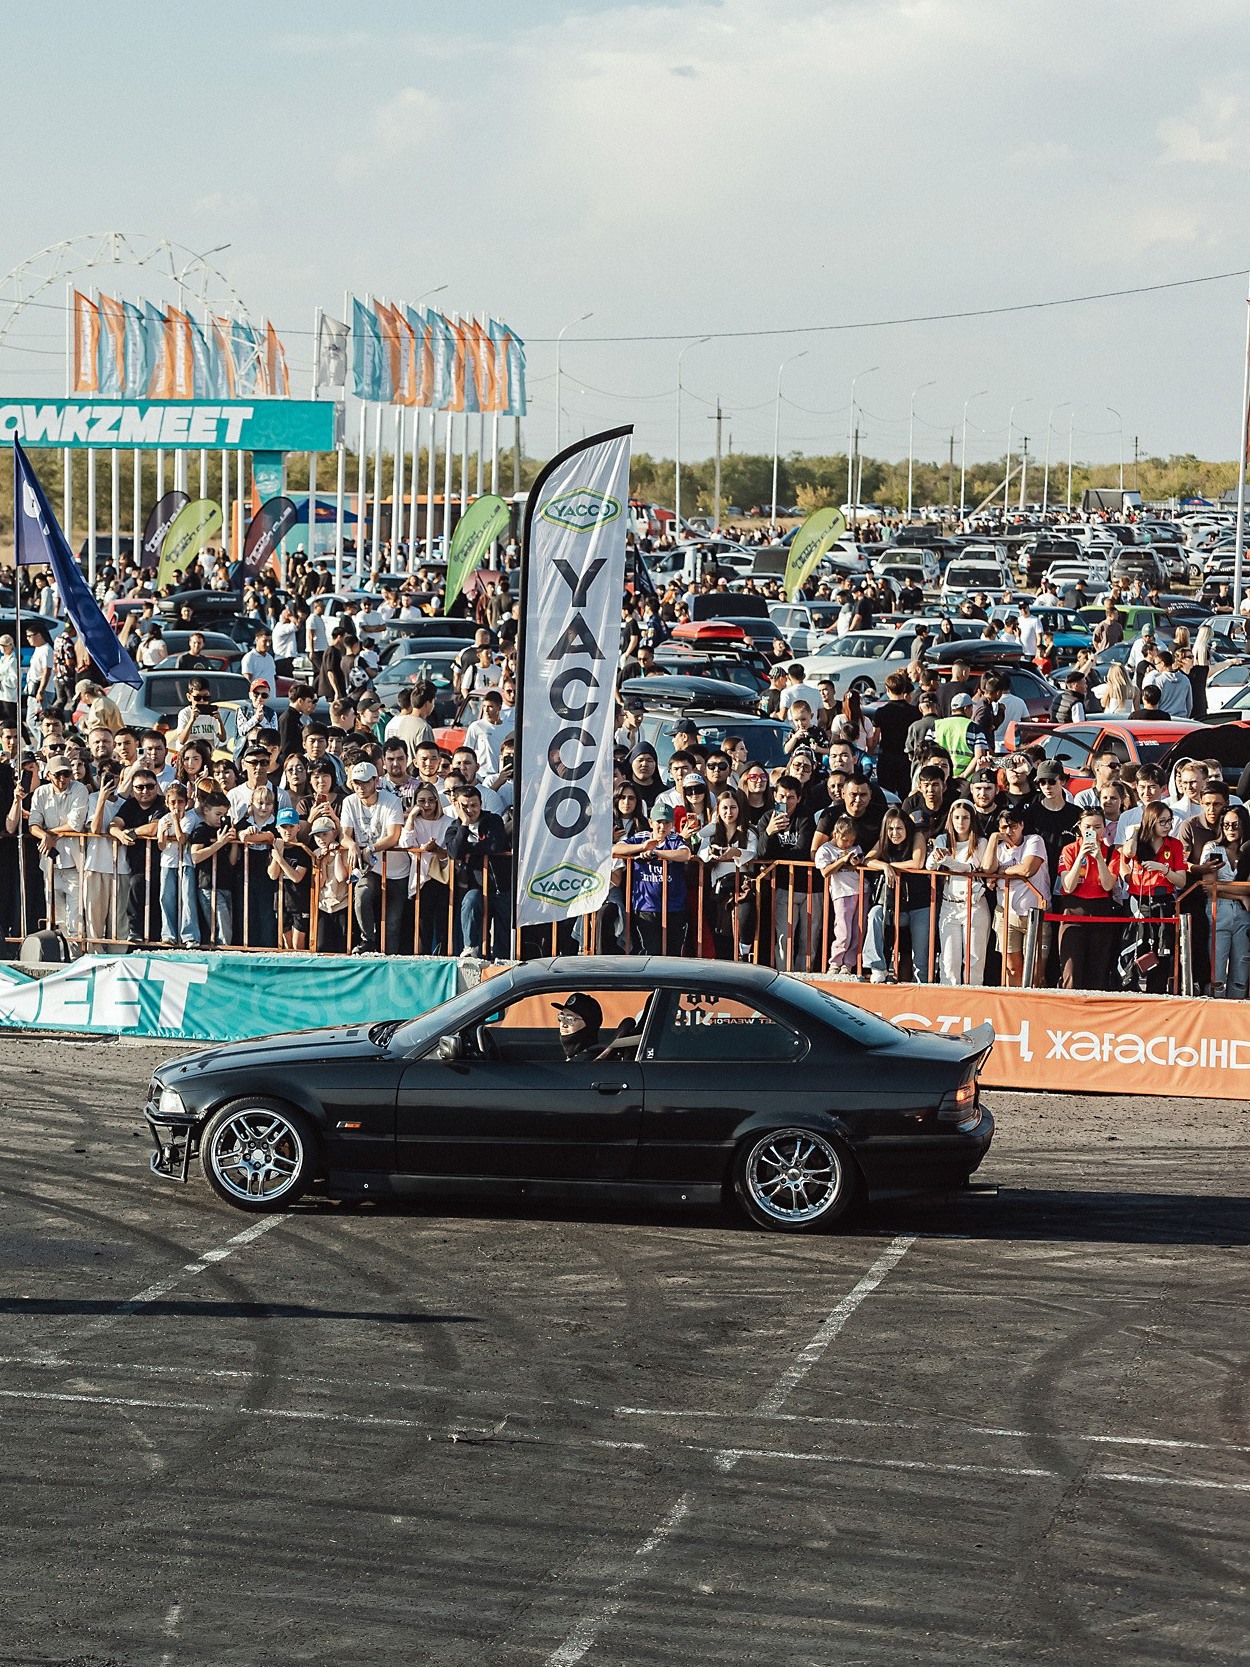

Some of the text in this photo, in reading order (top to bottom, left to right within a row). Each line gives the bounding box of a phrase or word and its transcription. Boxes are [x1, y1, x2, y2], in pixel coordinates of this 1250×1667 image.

[554, 502, 611, 518] YACCO
[543, 557, 609, 839] YACCO
[537, 877, 593, 894] YACCO
